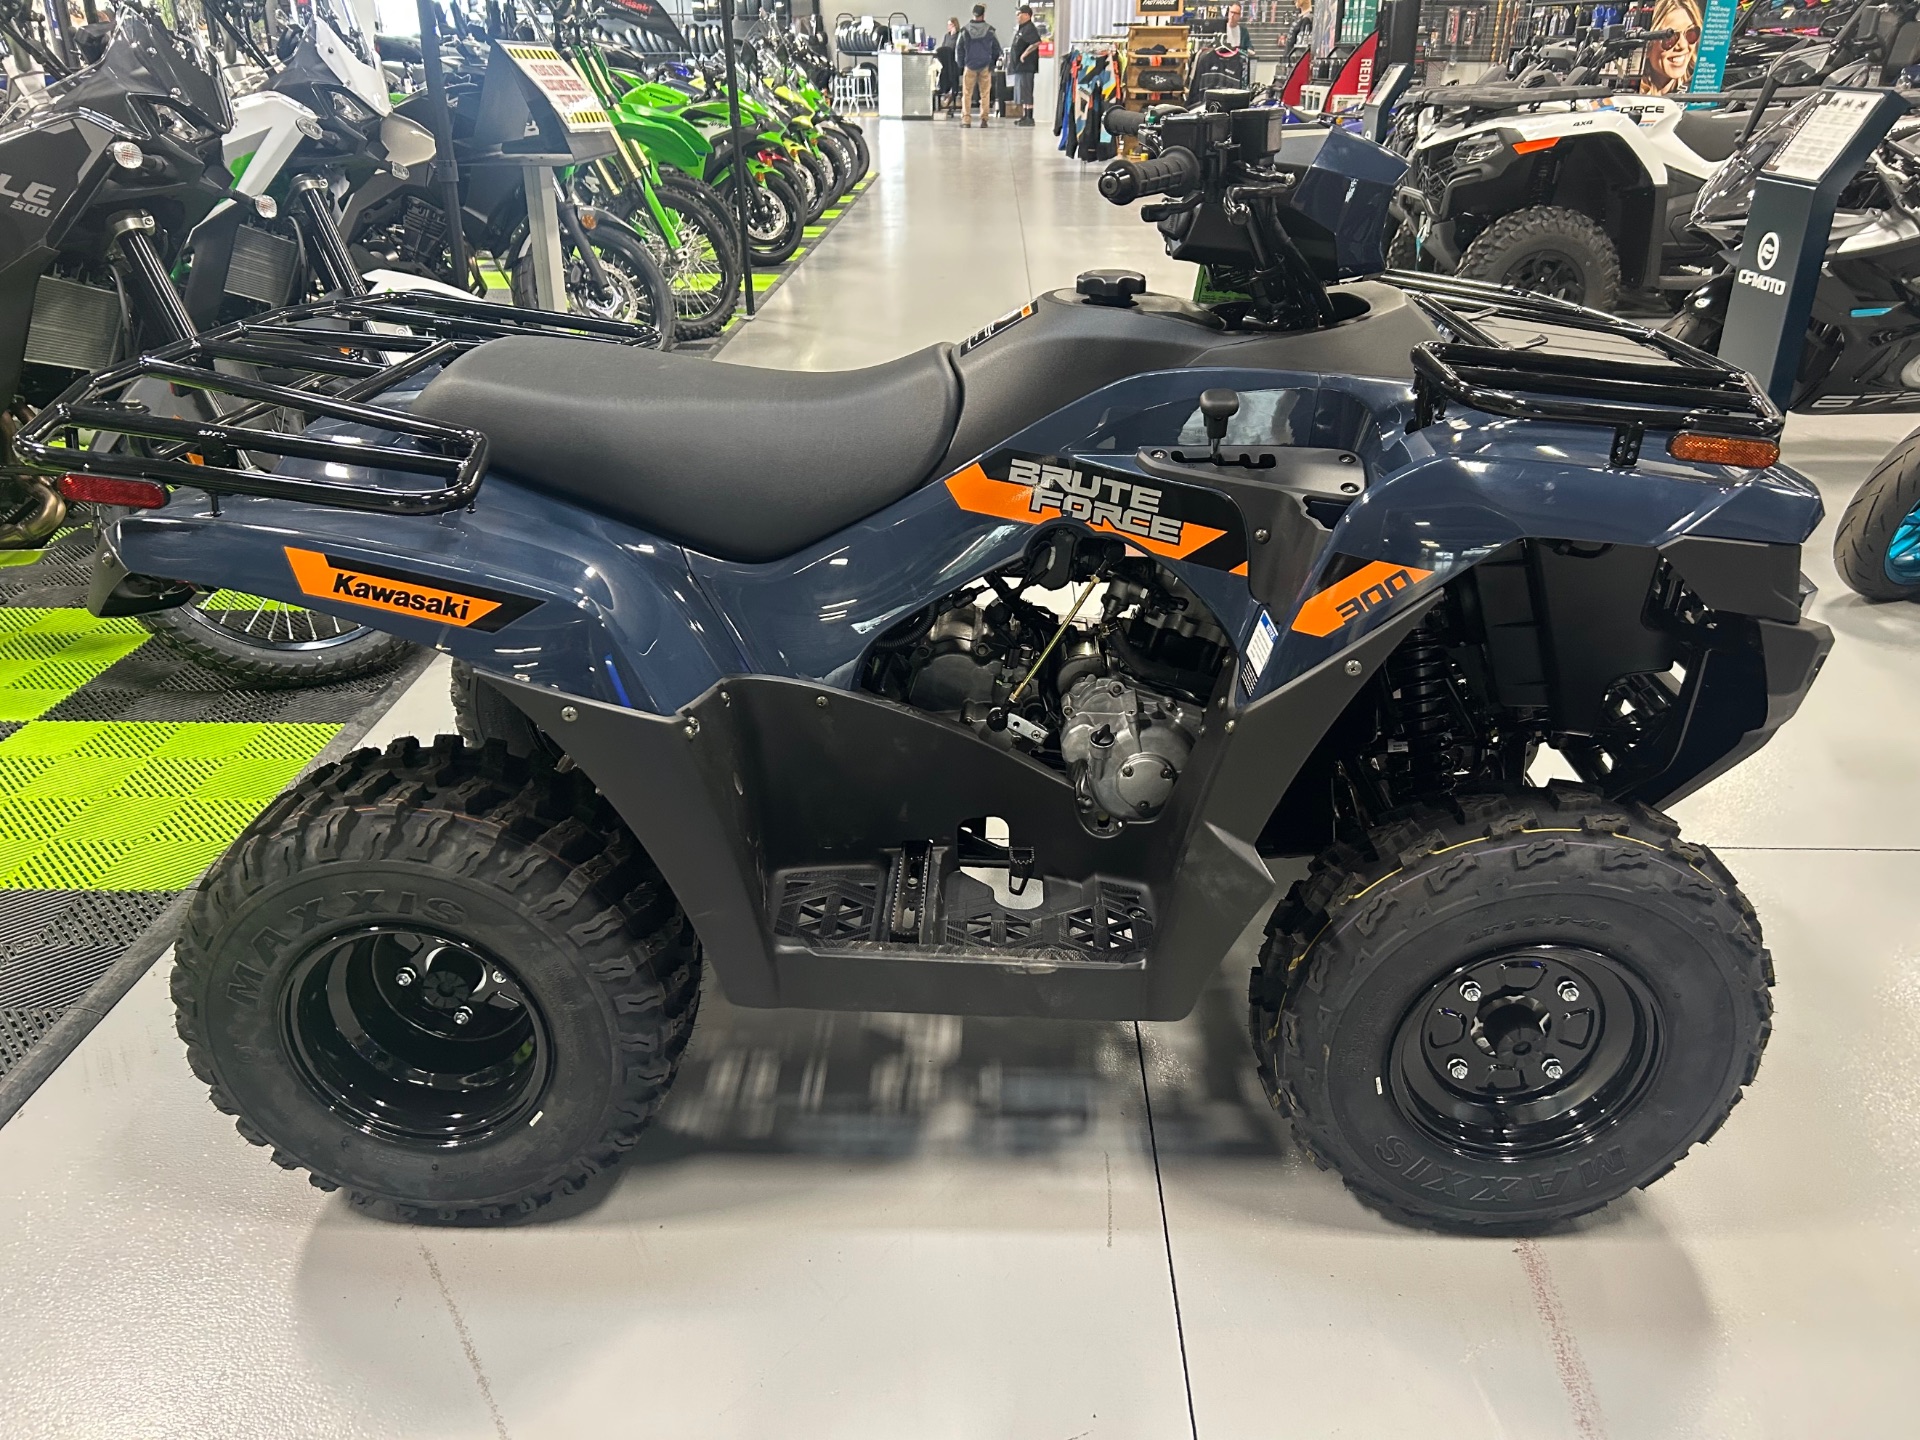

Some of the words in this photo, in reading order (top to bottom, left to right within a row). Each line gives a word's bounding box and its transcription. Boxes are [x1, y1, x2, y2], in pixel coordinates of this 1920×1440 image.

[1357, 58, 1372, 94] REDLI
[1615, 105, 1665, 114] ORCE
[9, 200, 52, 218] 500
[1738, 269, 1786, 296] CFMOTO
[1008, 458, 1163, 514] BRUTE
[1030, 488, 1182, 544] FORCE
[333, 572, 471, 620] Kawasaki
[1335, 569, 1415, 624] 300
[225, 888, 467, 1012] MAXXIS
[1374, 1134, 1630, 1201] MAXXIS
